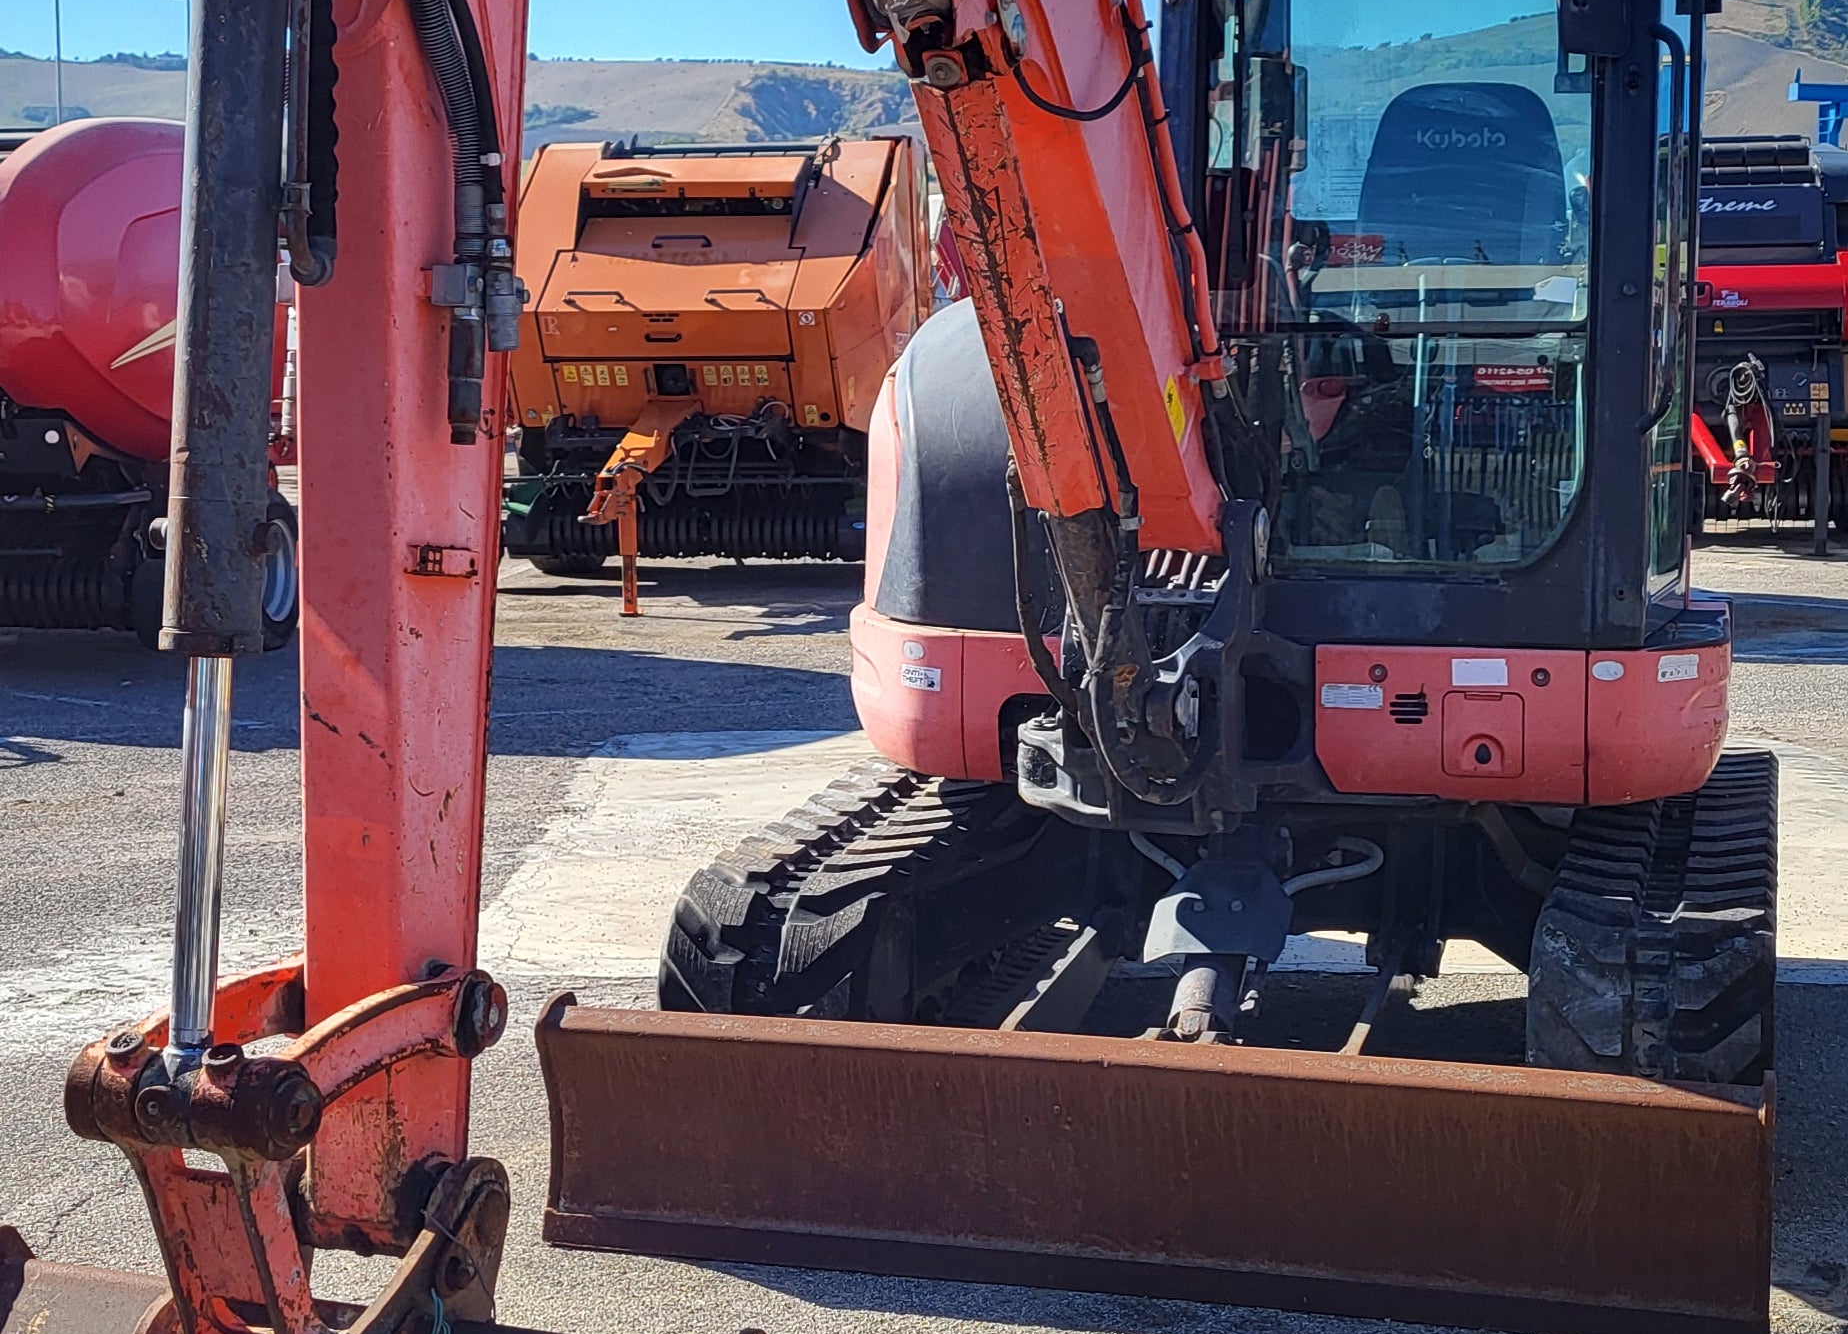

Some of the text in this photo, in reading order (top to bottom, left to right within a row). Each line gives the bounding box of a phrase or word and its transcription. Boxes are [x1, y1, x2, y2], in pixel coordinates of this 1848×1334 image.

[1416, 127, 1506, 150] Kubota
[1699, 196, 1778, 214] treme
[902, 675, 924, 684] THEFT
